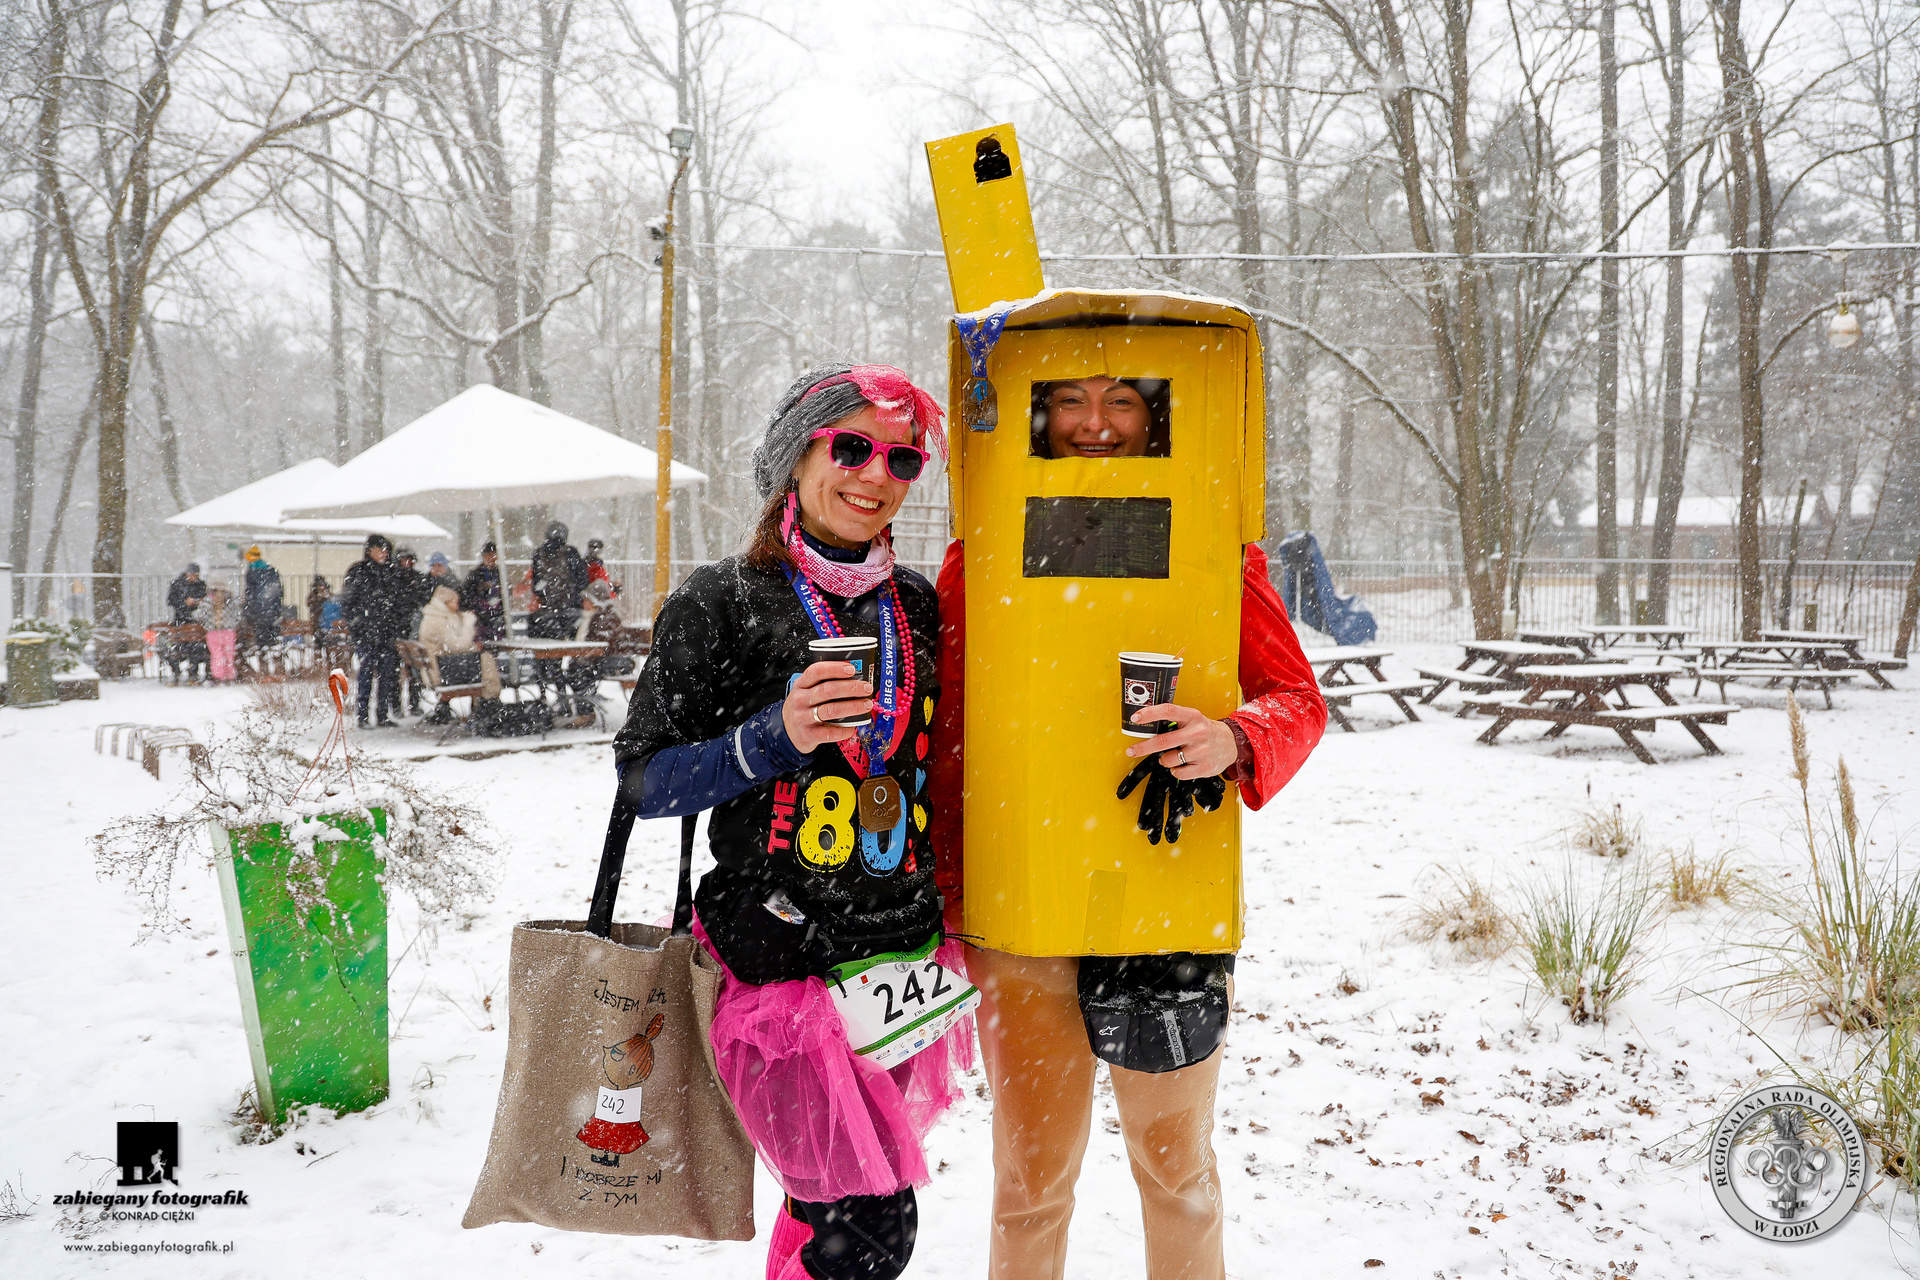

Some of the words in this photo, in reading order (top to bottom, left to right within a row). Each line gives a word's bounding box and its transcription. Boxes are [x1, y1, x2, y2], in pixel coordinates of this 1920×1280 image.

[882, 605, 894, 676] SYLWESTROWY
[768, 780, 798, 855] THE
[594, 979, 640, 1012] JESTEM
[872, 961, 952, 1025] 242
[601, 1094, 625, 1115] 242
[576, 1166, 639, 1188] DOBRZE
[646, 1169, 662, 1185] MI
[604, 1192, 638, 1208] TYM
